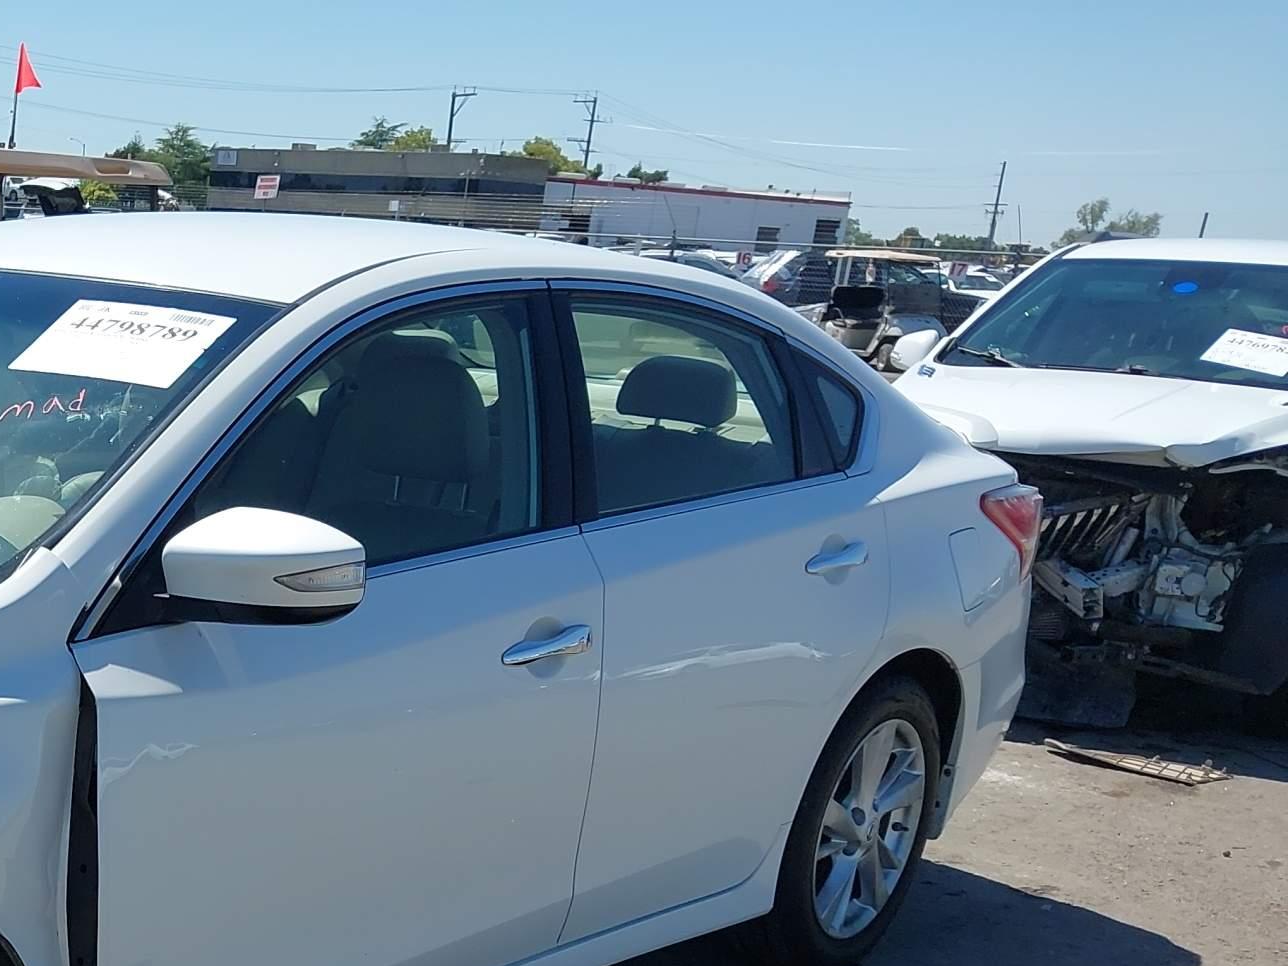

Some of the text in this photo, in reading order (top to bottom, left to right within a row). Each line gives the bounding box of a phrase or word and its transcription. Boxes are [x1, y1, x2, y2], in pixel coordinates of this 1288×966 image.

[737, 252, 752, 265] 16
[949, 263, 968, 276] 17
[71, 316, 198, 342] 44798789
[1227, 338, 1288, 354] 4476978
